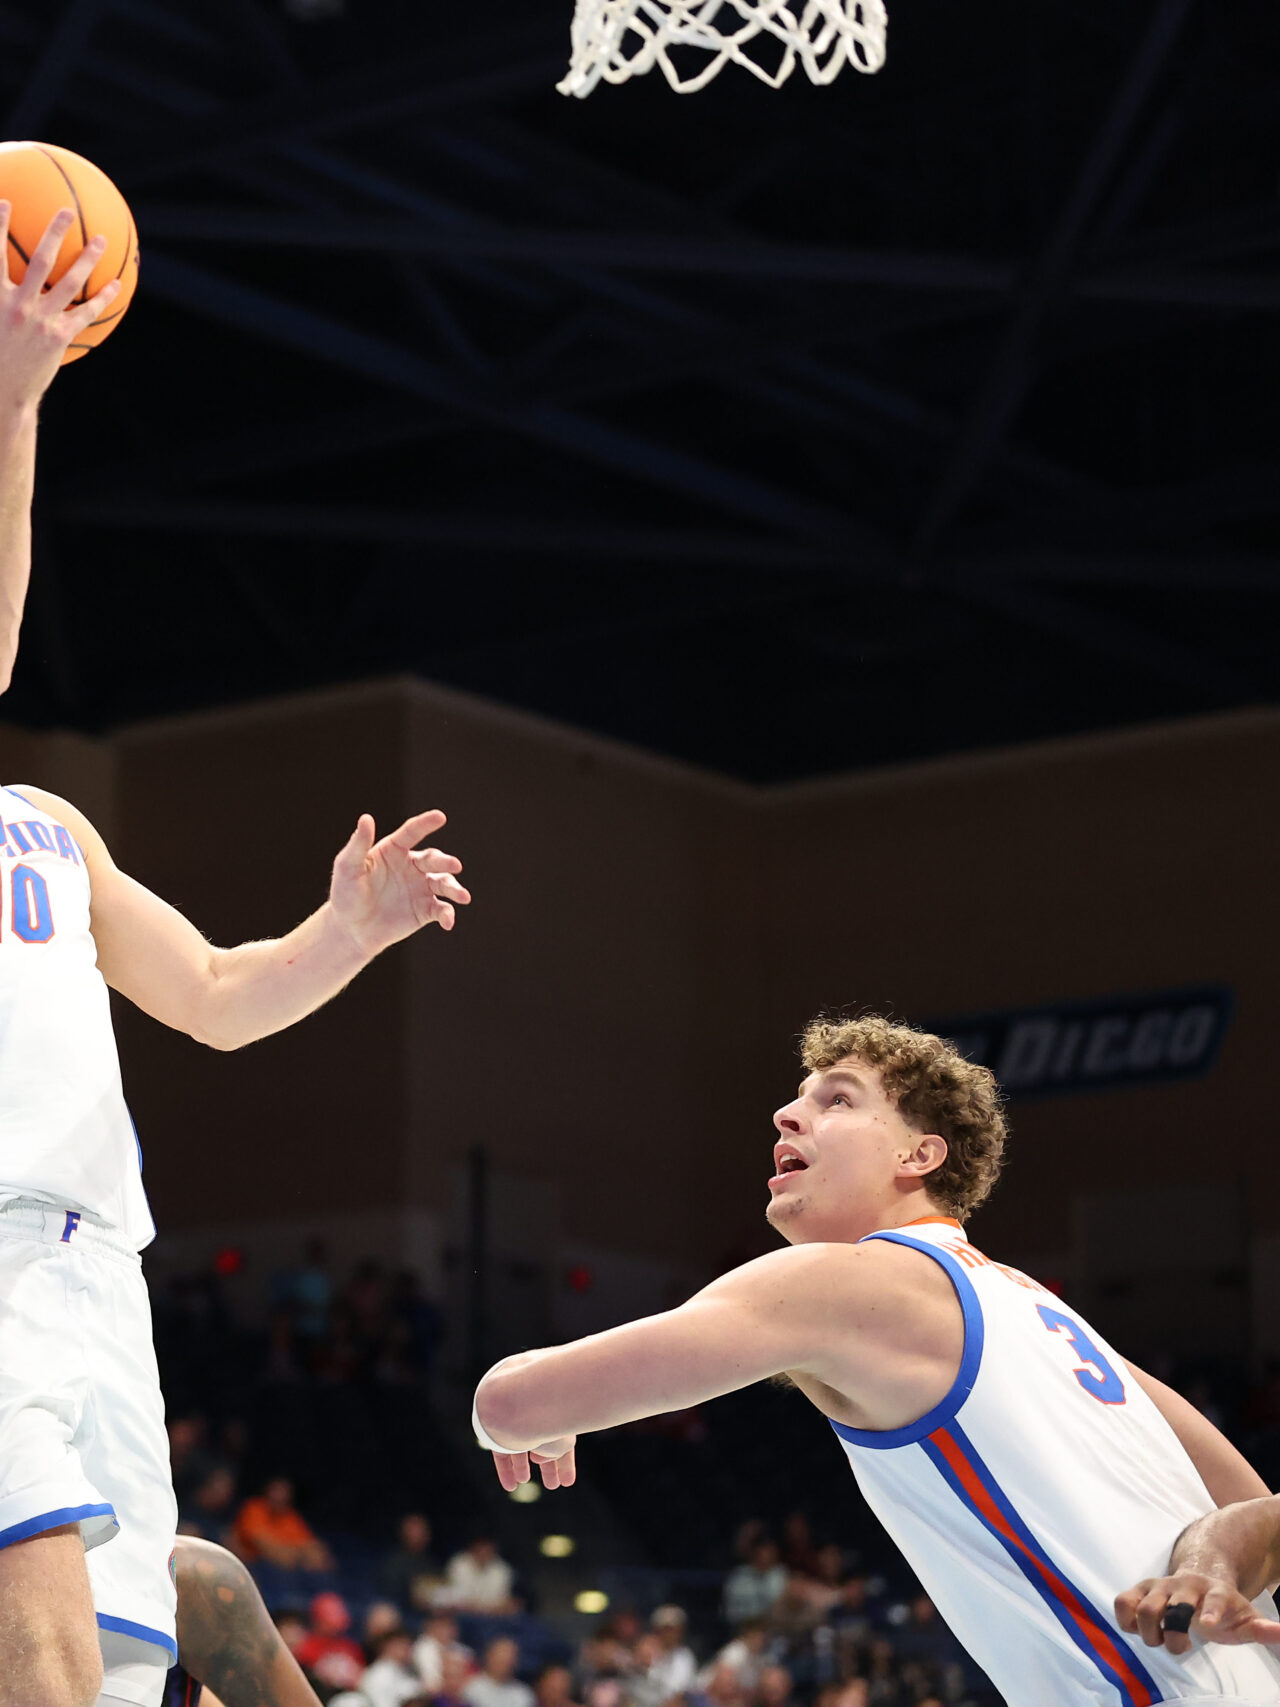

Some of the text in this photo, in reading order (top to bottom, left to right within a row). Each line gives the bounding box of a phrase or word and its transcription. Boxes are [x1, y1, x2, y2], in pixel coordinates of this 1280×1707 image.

[998, 1004, 1217, 1086] DIEGO
[59, 1209, 81, 1243] F
[1035, 1303, 1126, 1405] 3
